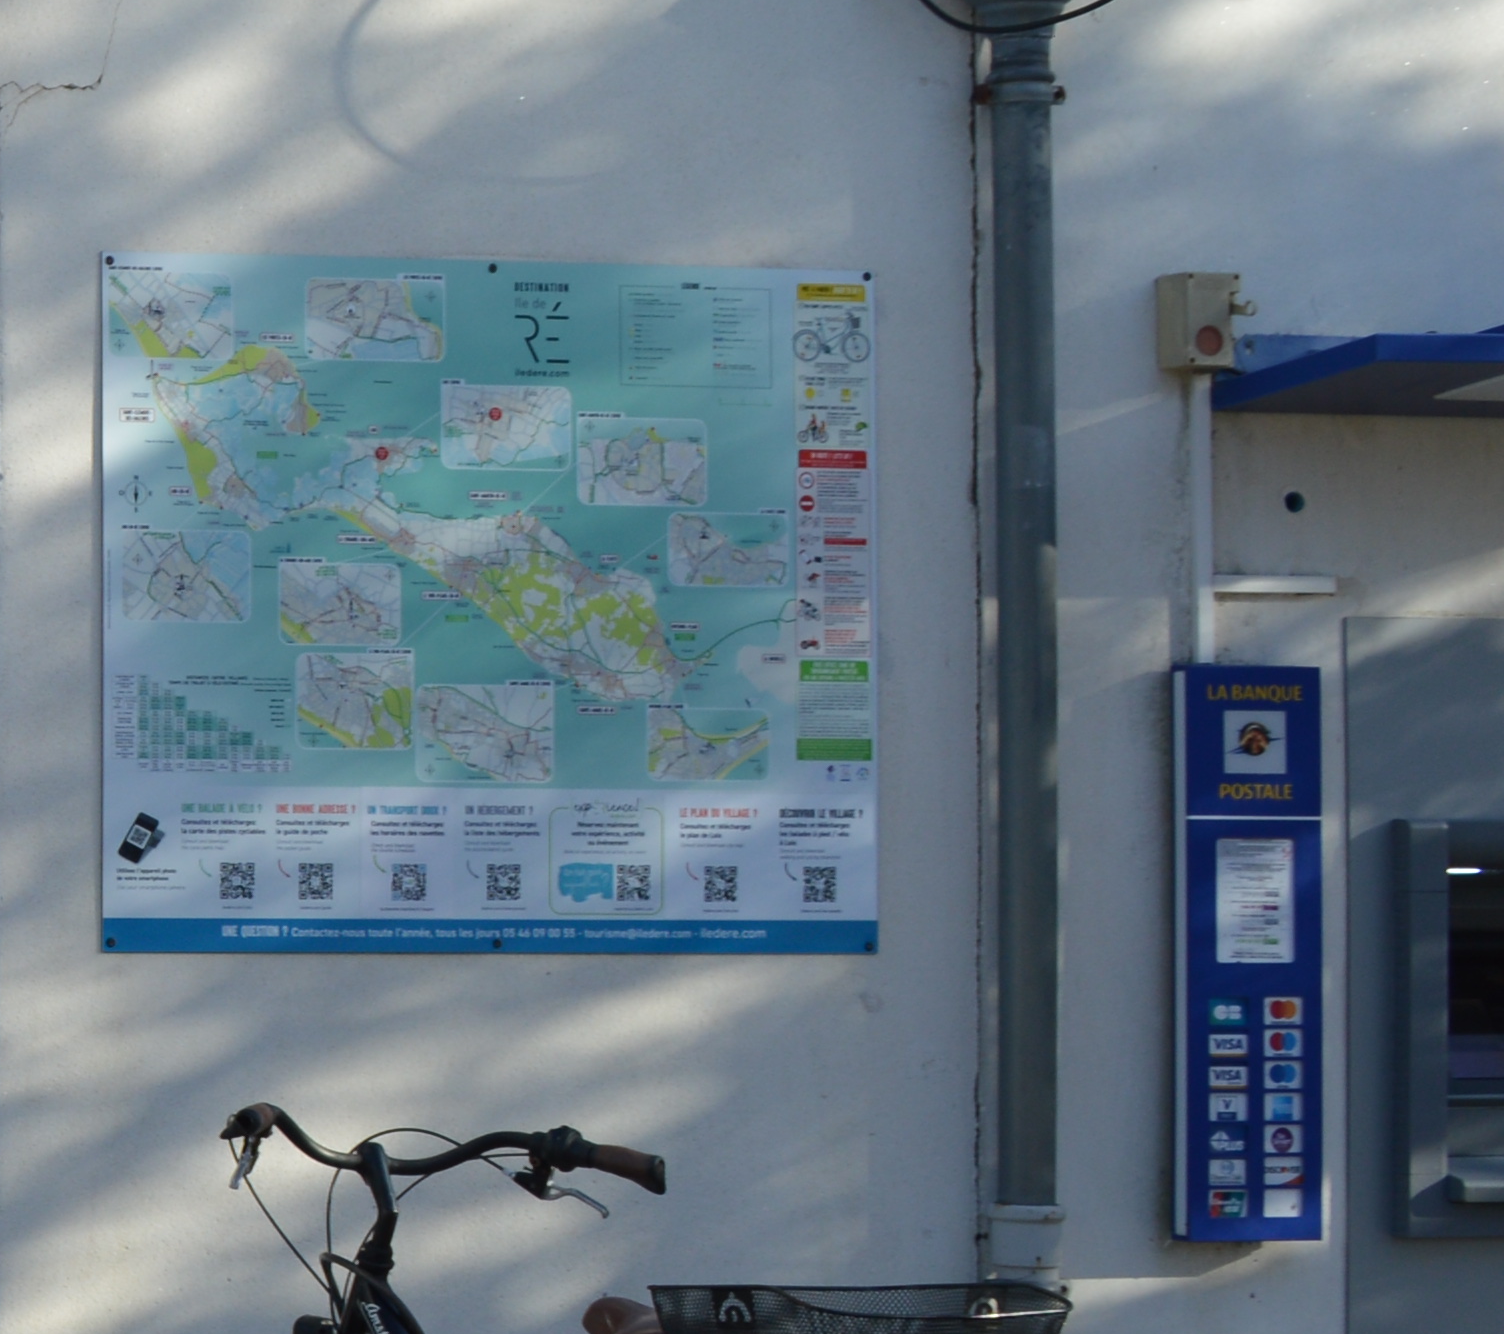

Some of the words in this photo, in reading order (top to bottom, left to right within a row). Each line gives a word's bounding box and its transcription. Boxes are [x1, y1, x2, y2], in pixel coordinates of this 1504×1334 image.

[514, 282, 569, 292] DESTINATION
[1206, 684, 1229, 703] LA
[1230, 684, 1304, 703] BANQUE
[1218, 783, 1293, 801] POSTALE
[1213, 1038, 1243, 1050] VISA
[1211, 1069, 1241, 1081] VISA
